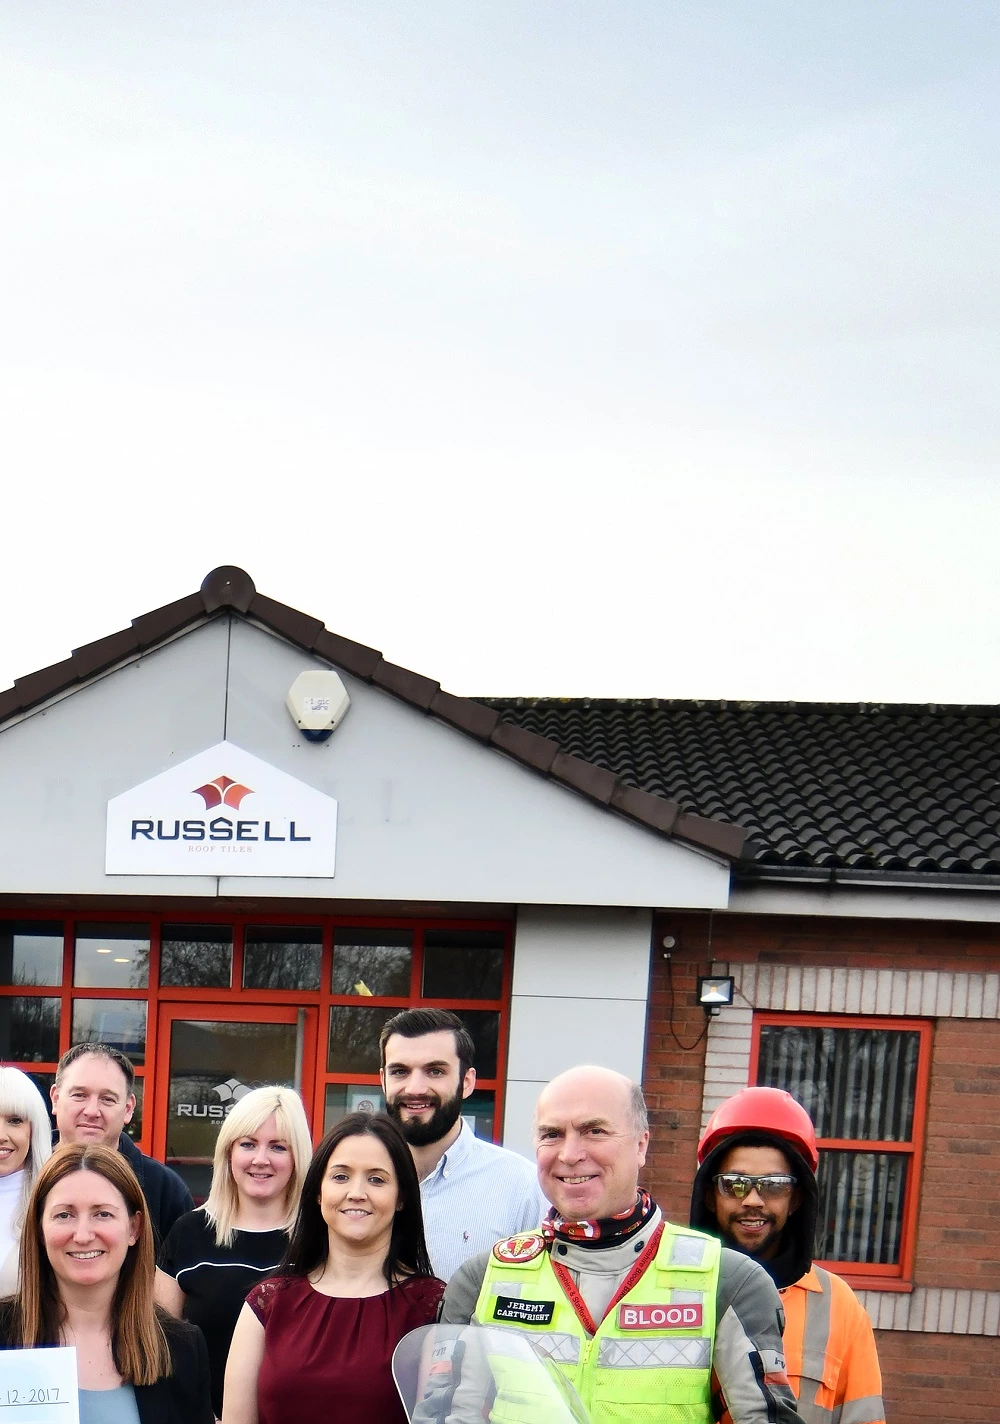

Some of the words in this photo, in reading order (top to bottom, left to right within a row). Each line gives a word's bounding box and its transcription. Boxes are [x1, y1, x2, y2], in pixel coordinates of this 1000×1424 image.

[131, 816, 311, 841] RUSSELL
[177, 1103, 235, 1117] RUSS
[627, 1267, 642, 1286] Blood
[507, 1301, 545, 1312] JEREMY
[496, 1309, 550, 1321] CARTWRIGHT
[624, 1308, 697, 1325] BLOOD
